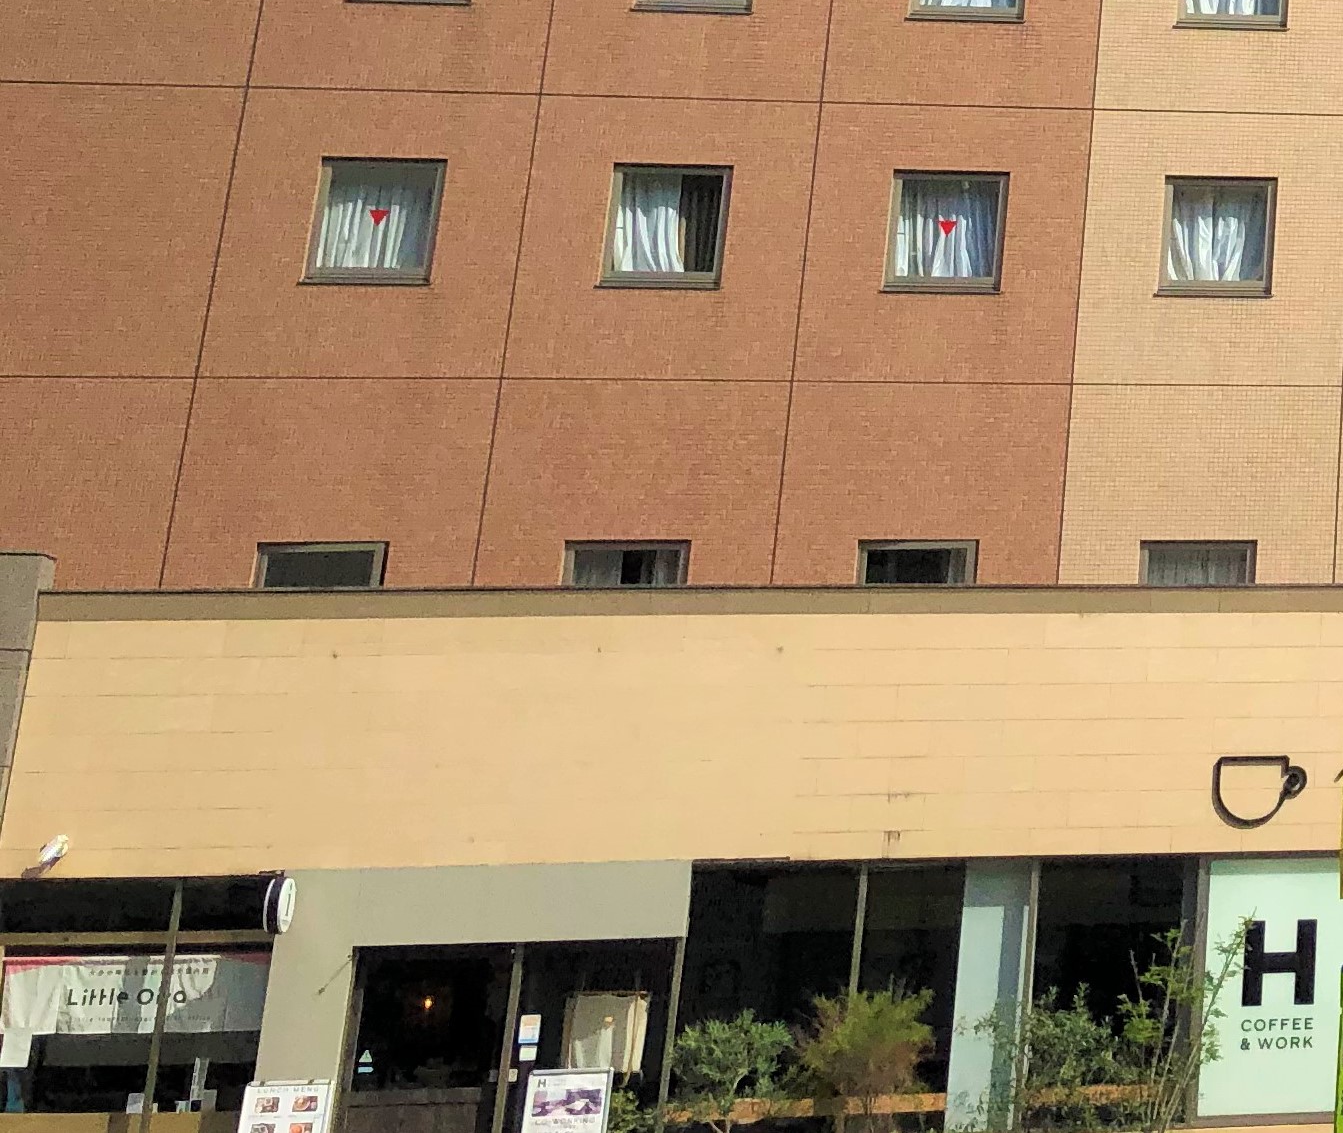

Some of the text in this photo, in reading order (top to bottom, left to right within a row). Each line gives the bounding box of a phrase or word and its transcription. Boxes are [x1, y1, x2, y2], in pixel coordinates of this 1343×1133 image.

[1241, 919, 1317, 1007] H
[67, 988, 129, 1006] Little
[1241, 1017, 1314, 1032] COFFEE
[1240, 1036, 1313, 1051] & WORK
